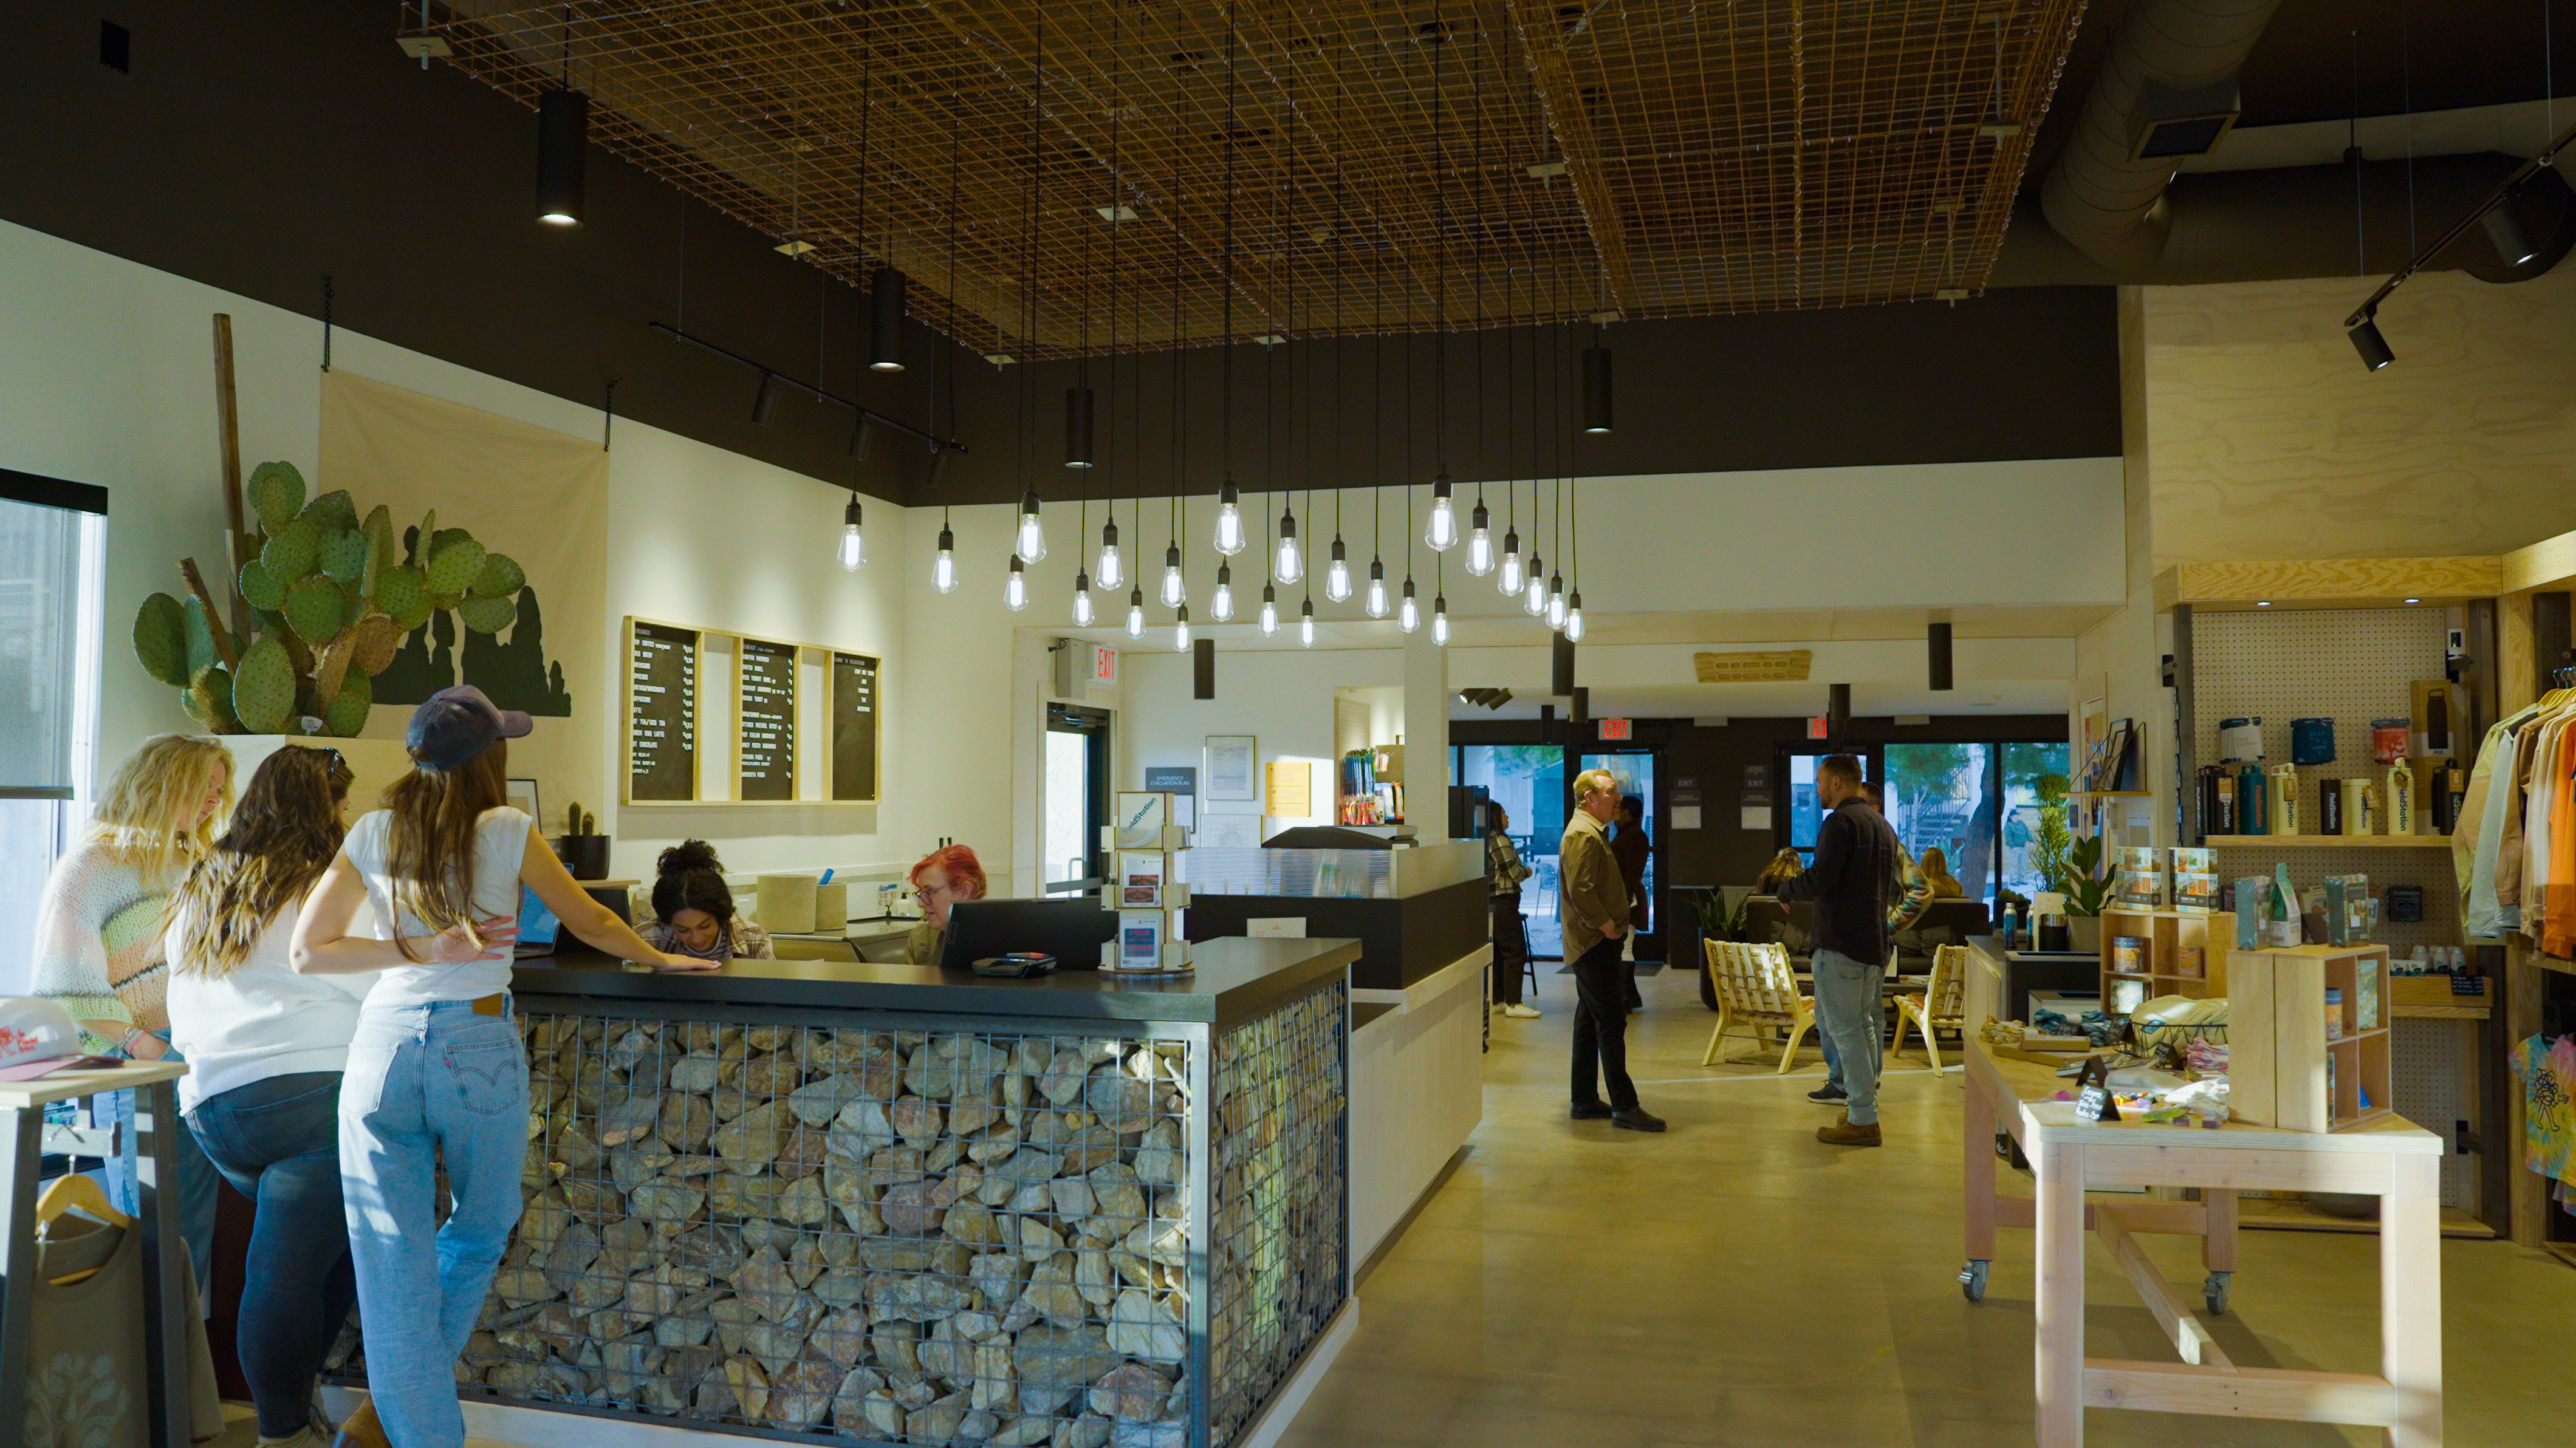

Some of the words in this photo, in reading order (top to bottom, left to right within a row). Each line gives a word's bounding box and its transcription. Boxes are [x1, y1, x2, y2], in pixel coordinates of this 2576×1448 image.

[1098, 648, 1115, 680] EXIT
[1605, 719, 1627, 738] EXIT
[1814, 719, 1828, 737] EX
